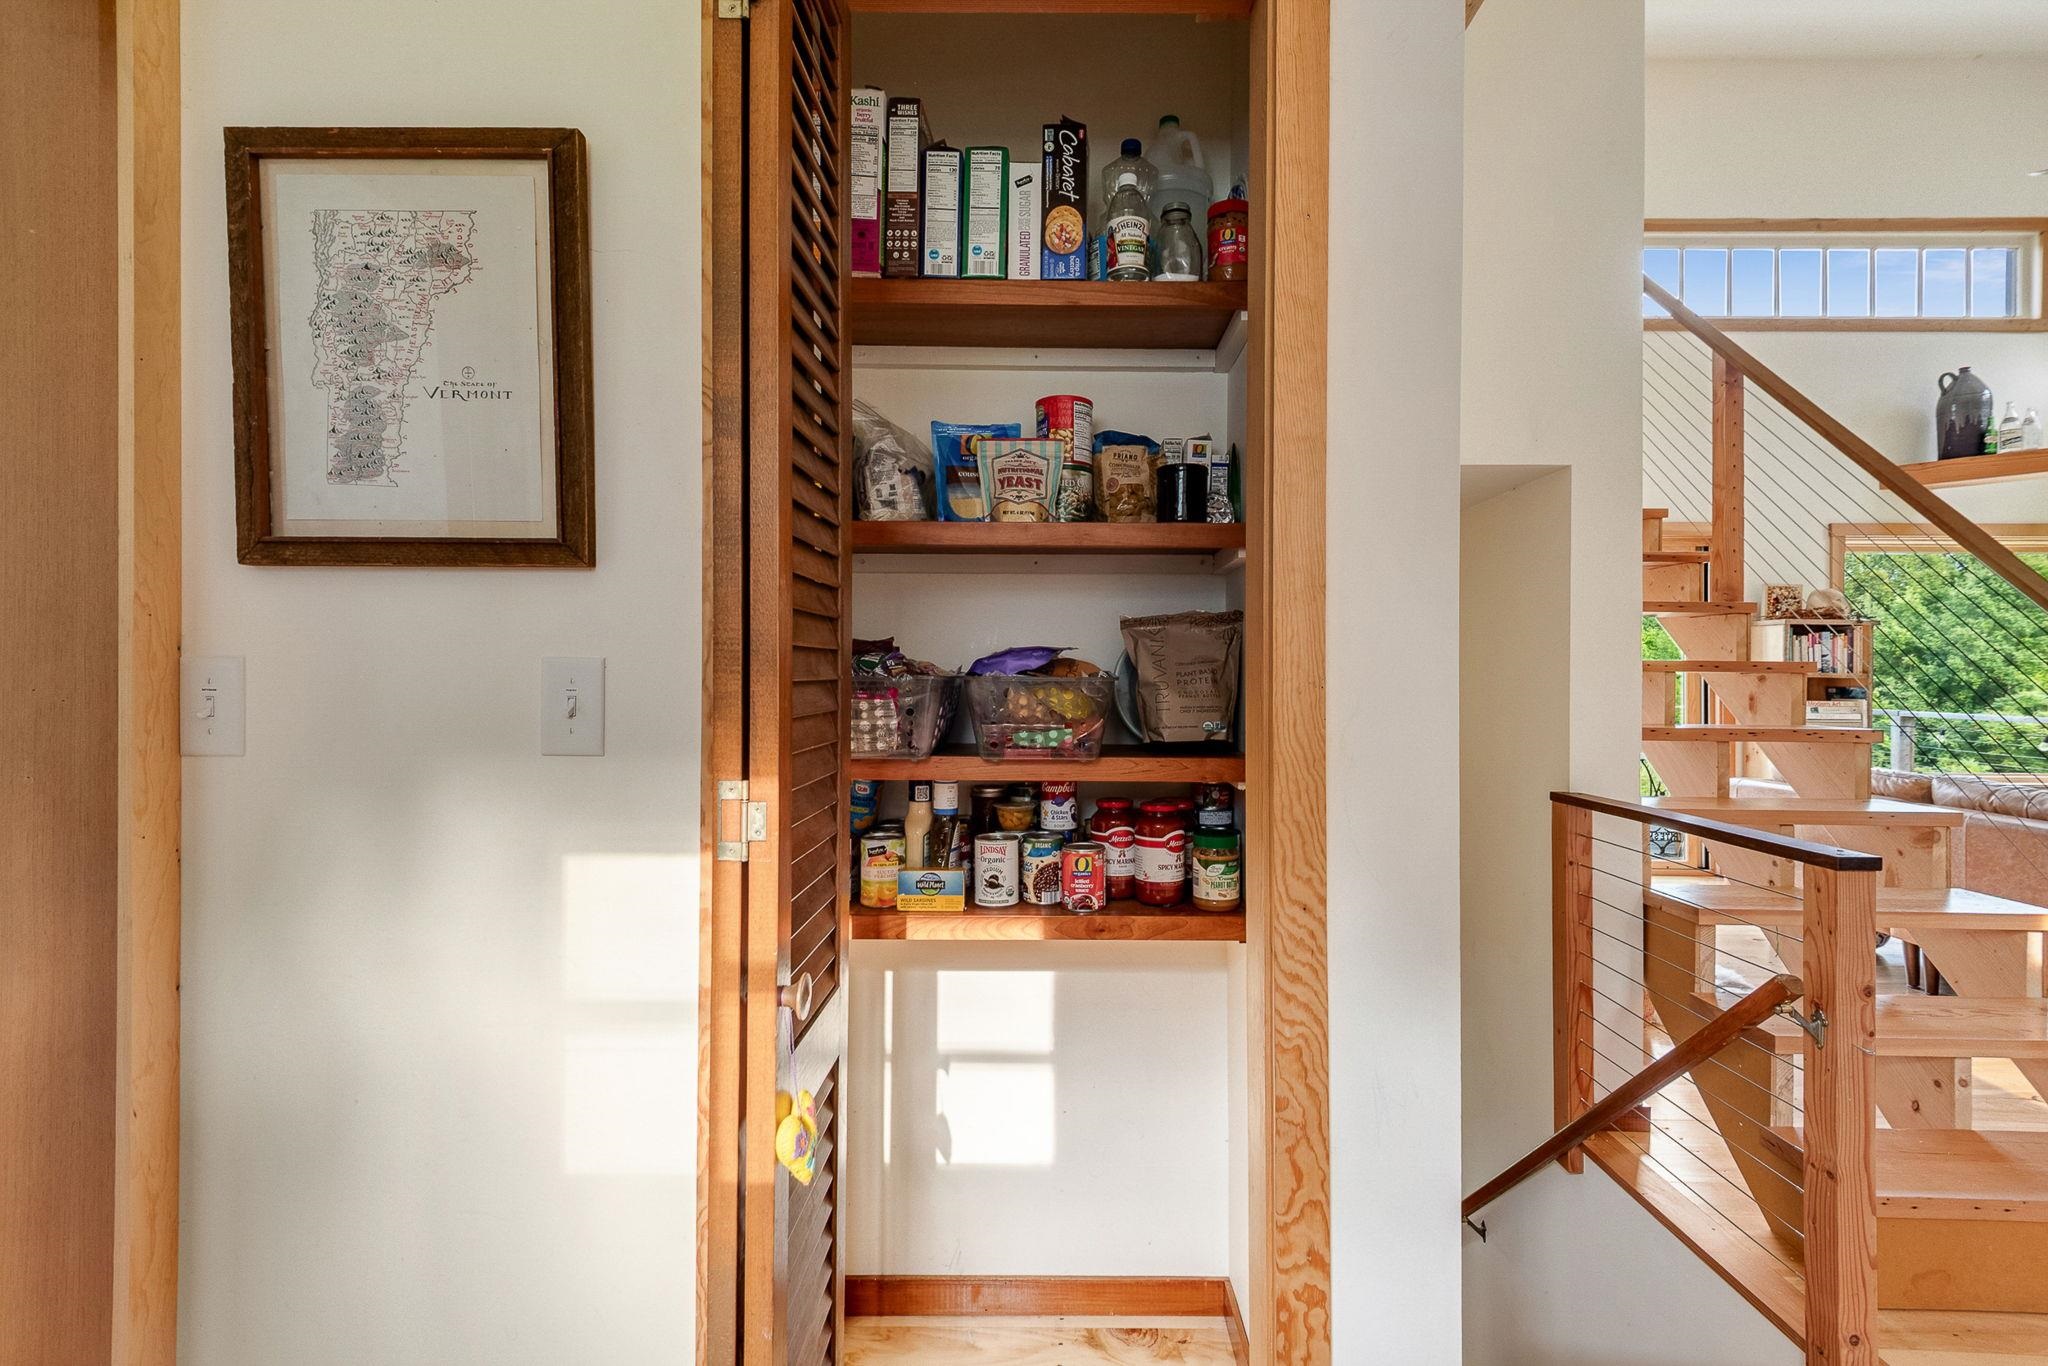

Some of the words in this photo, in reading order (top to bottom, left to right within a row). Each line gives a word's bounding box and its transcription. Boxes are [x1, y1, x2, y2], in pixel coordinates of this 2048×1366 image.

[851, 96, 880, 107] Kashi
[1058, 129, 1081, 202] Cabaret
[1019, 190, 1031, 217] SUGAR
[1120, 221, 1143, 230] HEINZ
[1019, 231, 1031, 277] GRANULATED
[423, 386, 512, 401] VERMONT
[997, 467, 1044, 476] NUTRITIONAL
[997, 476, 1043, 490] YEAST
[1150, 639, 1171, 714] TRUVANI
[980, 845, 1007, 856] LINDSAY
[980, 856, 1006, 864] Organic
[930, 881, 945, 889] Planet
